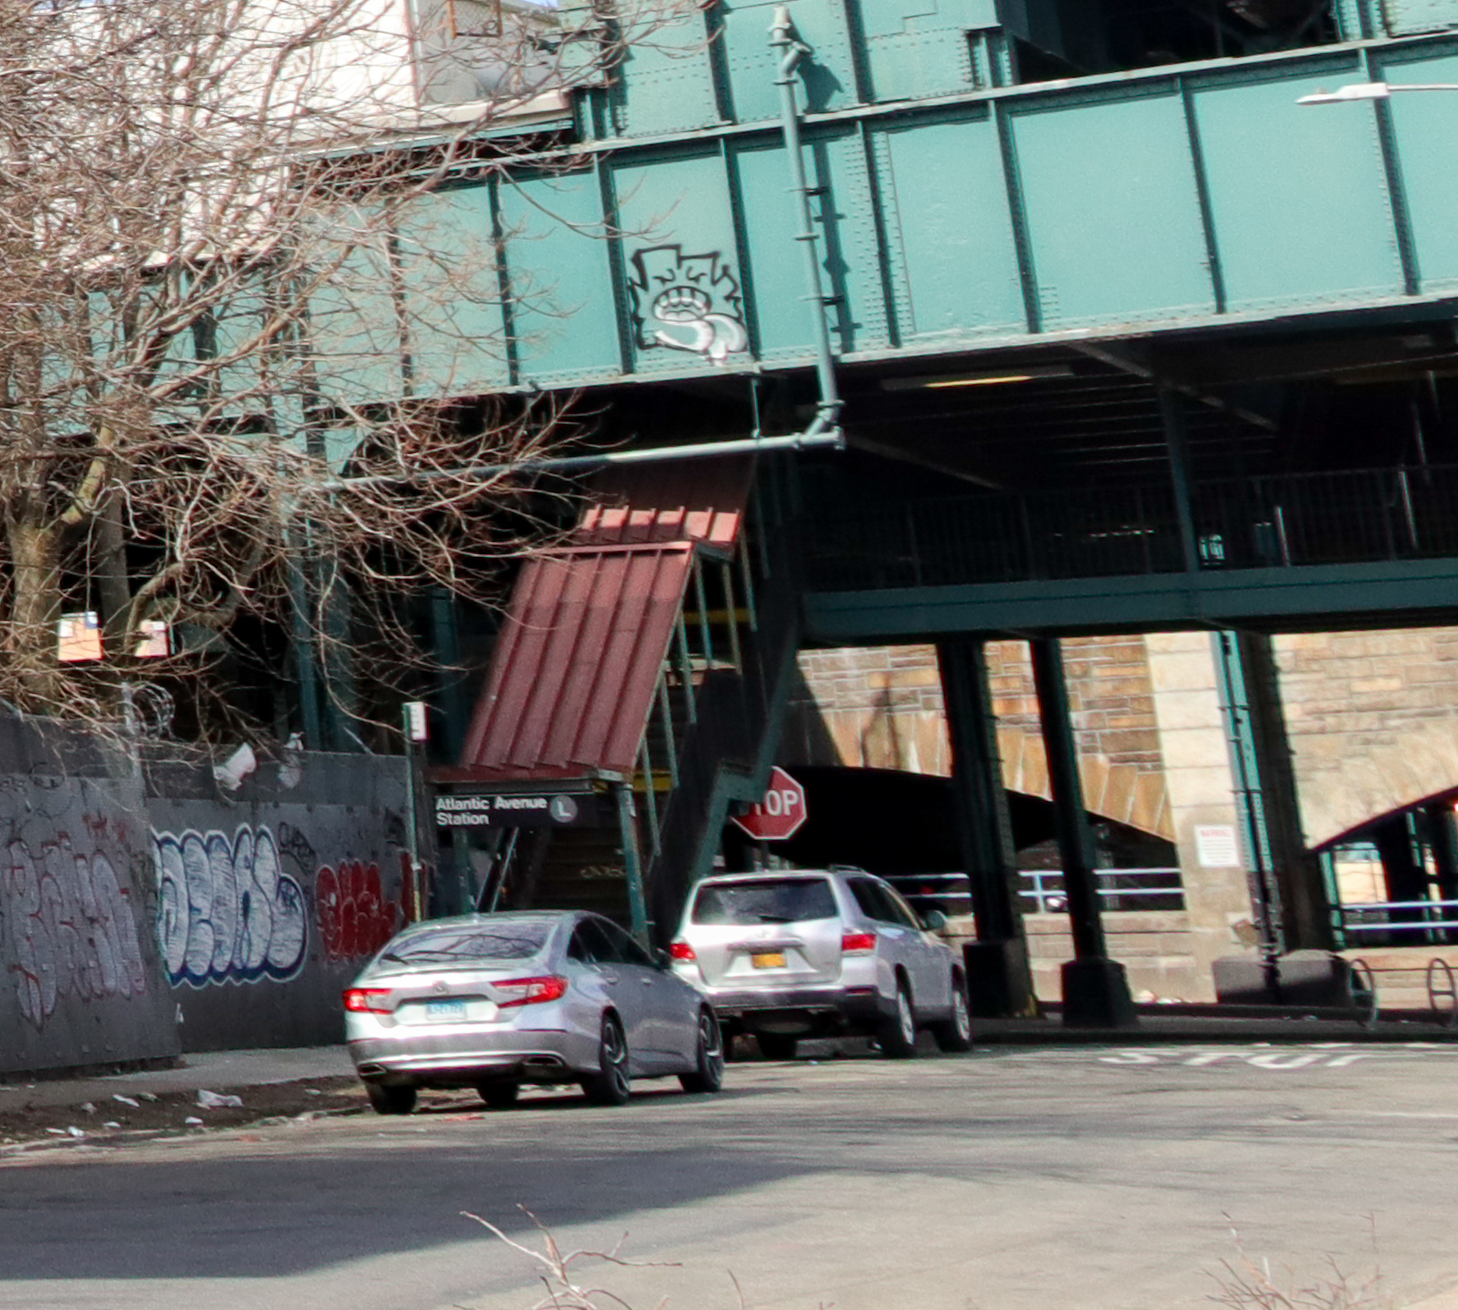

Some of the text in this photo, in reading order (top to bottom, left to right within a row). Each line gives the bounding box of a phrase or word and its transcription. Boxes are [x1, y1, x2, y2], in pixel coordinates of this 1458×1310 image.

[436, 795, 547, 811] Atlantic Avenue
[557, 801, 571, 817] L
[436, 811, 489, 826] Station
